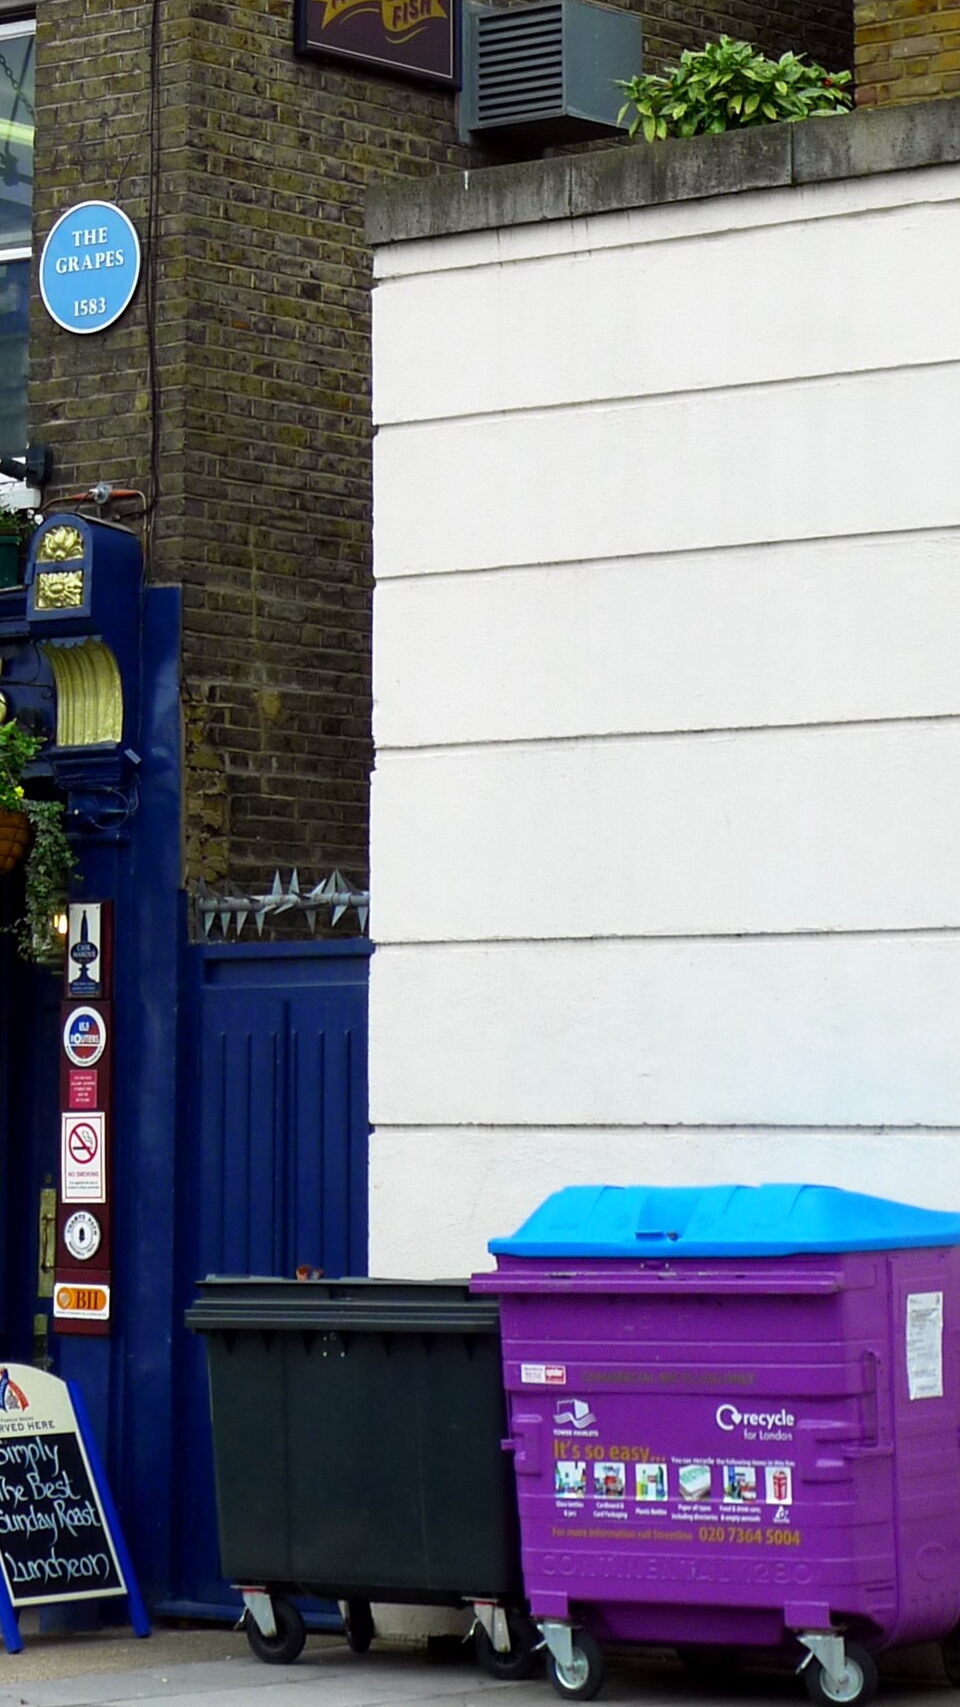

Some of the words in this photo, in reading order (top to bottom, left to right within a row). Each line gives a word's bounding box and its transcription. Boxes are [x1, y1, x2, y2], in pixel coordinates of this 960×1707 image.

[71, 227, 108, 247] THE
[55, 249, 124, 275] GRAPES
[73, 297, 107, 317] 1583
[27, 1420, 55, 1431] HERE
[743, 1408, 795, 1430] recycle
[553, 1429, 572, 1437] TOWER
[573, 1429, 599, 1437] HAMLETS
[744, 1429, 757, 1441] for
[759, 1429, 793, 1442] London
[553, 1440, 580, 1459] It's
[584, 1445, 605, 1460] so
[26, 1470, 81, 1501] Best
[53, 1500, 101, 1537] Roast
[700, 1526, 725, 1542] 020
[727, 1527, 762, 1543] 7364
[765, 1529, 800, 1546] 5004
[4, 1547, 109, 1584] Luncheon
